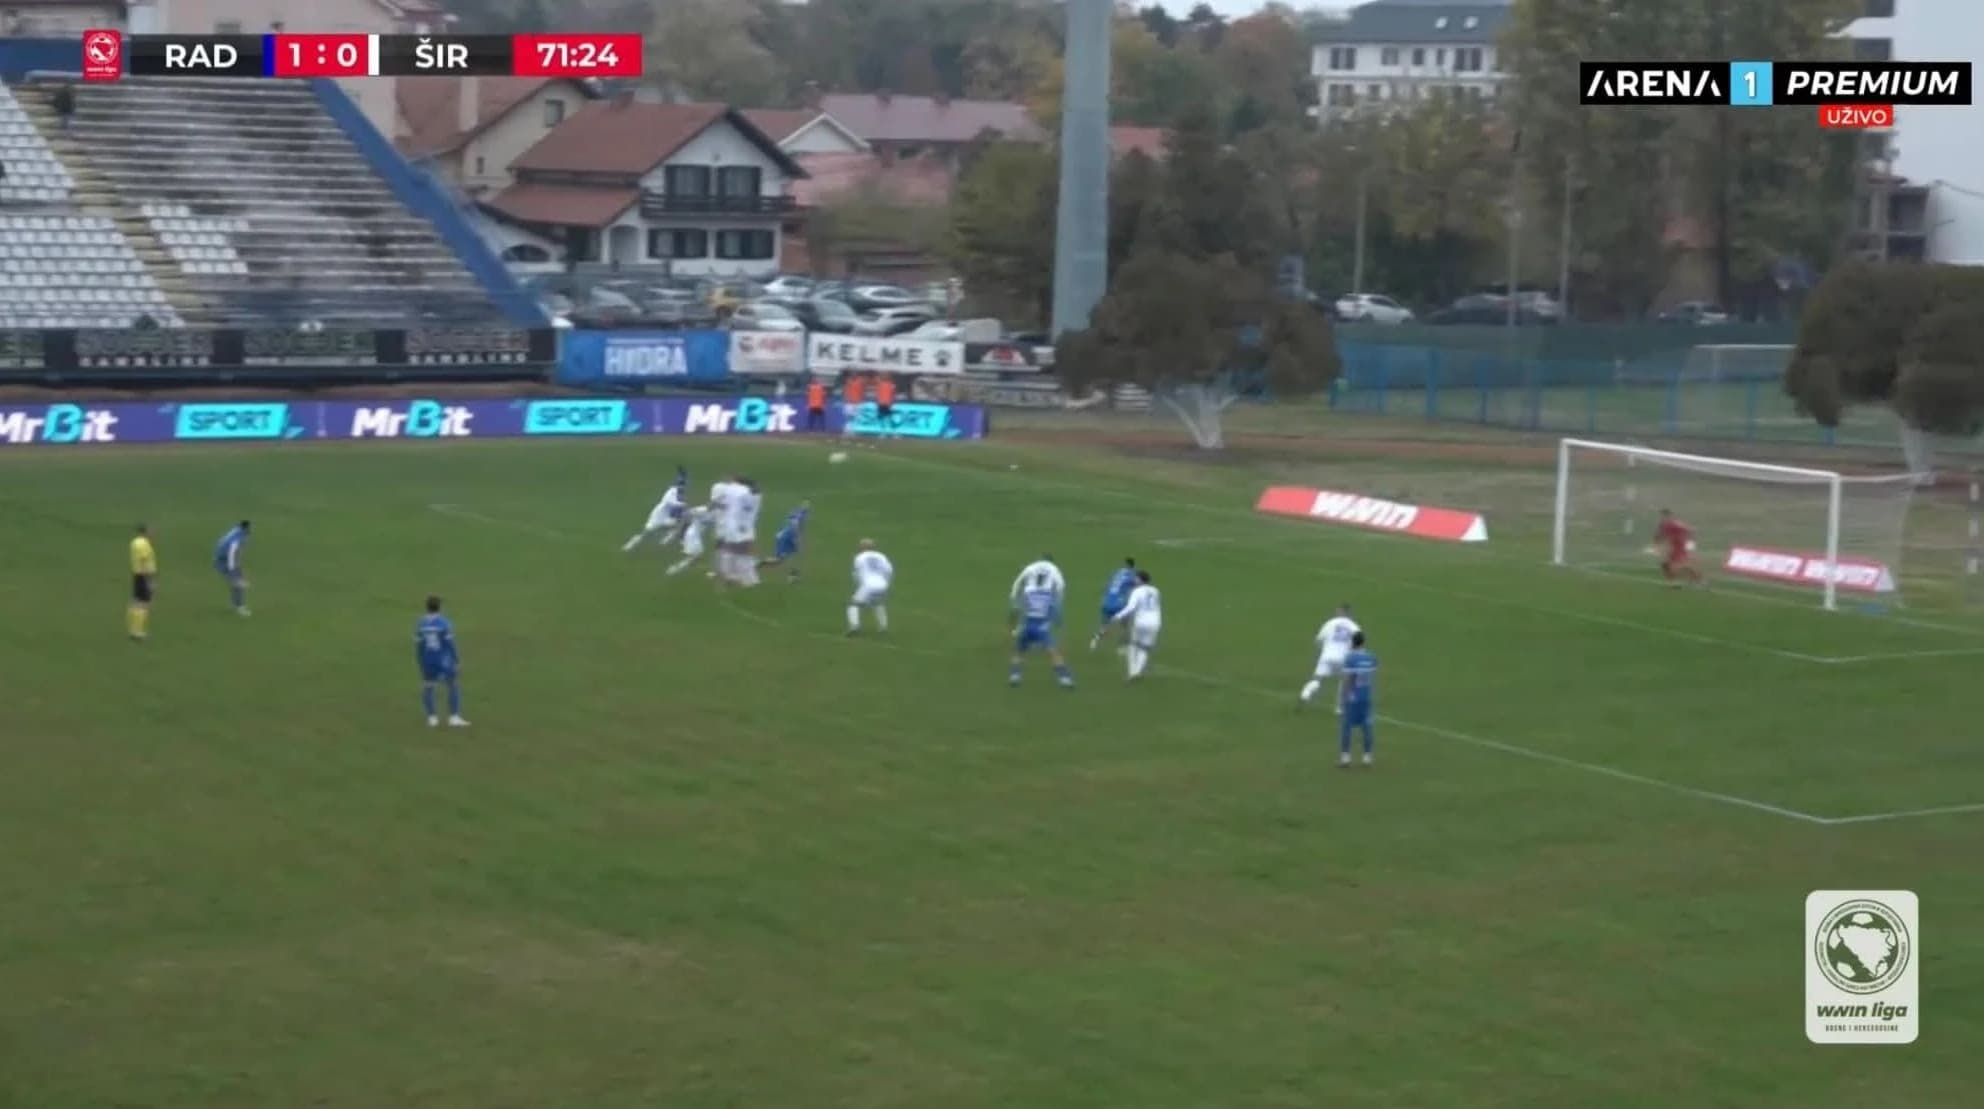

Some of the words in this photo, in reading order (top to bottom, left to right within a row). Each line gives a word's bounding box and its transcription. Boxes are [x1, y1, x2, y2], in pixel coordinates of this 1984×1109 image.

[816, 341, 923, 367] KELME
[187, 410, 274, 431] SPORT
[351, 400, 474, 437] MrBit
[534, 406, 613, 426] SPORT
[684, 398, 798, 433] MrBit
[855, 408, 935, 429] SORT
